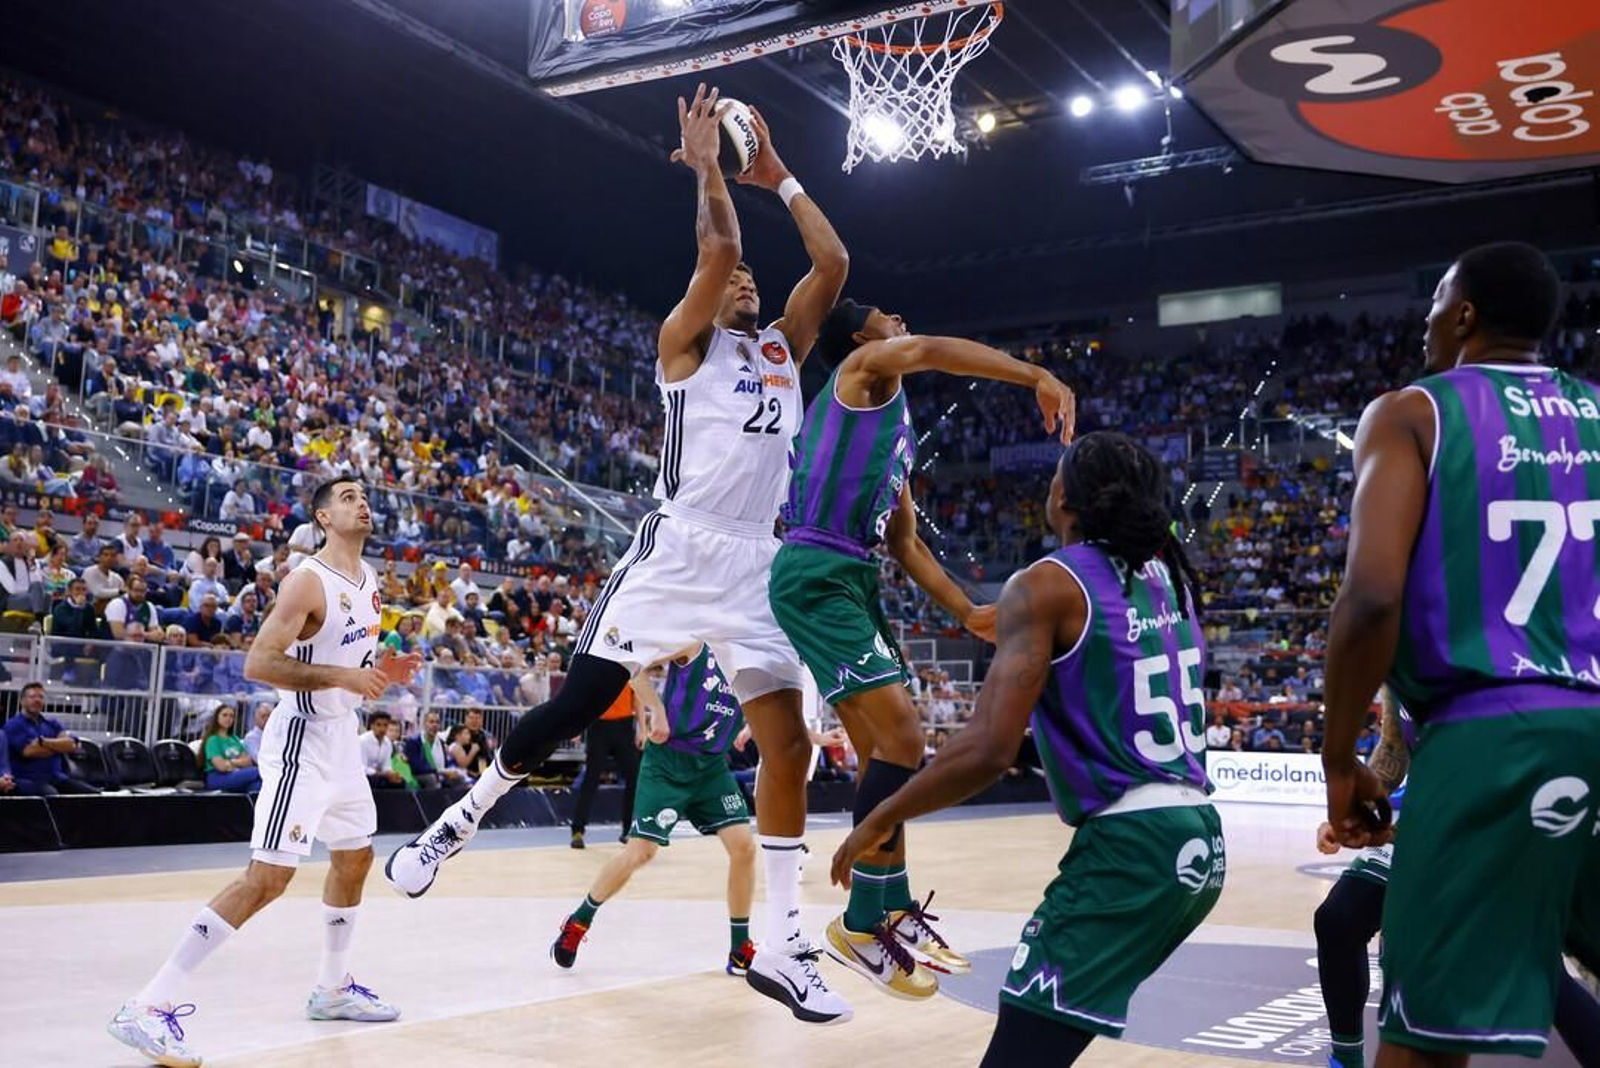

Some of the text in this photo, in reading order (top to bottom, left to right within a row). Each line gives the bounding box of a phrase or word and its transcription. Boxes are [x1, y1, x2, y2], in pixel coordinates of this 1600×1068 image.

[1435, 93, 1501, 135] acb
[1496, 52, 1594, 141] Copa
[743, 397, 782, 434] 22
[1134, 647, 1206, 763] 55
[703, 721, 719, 741] 4
